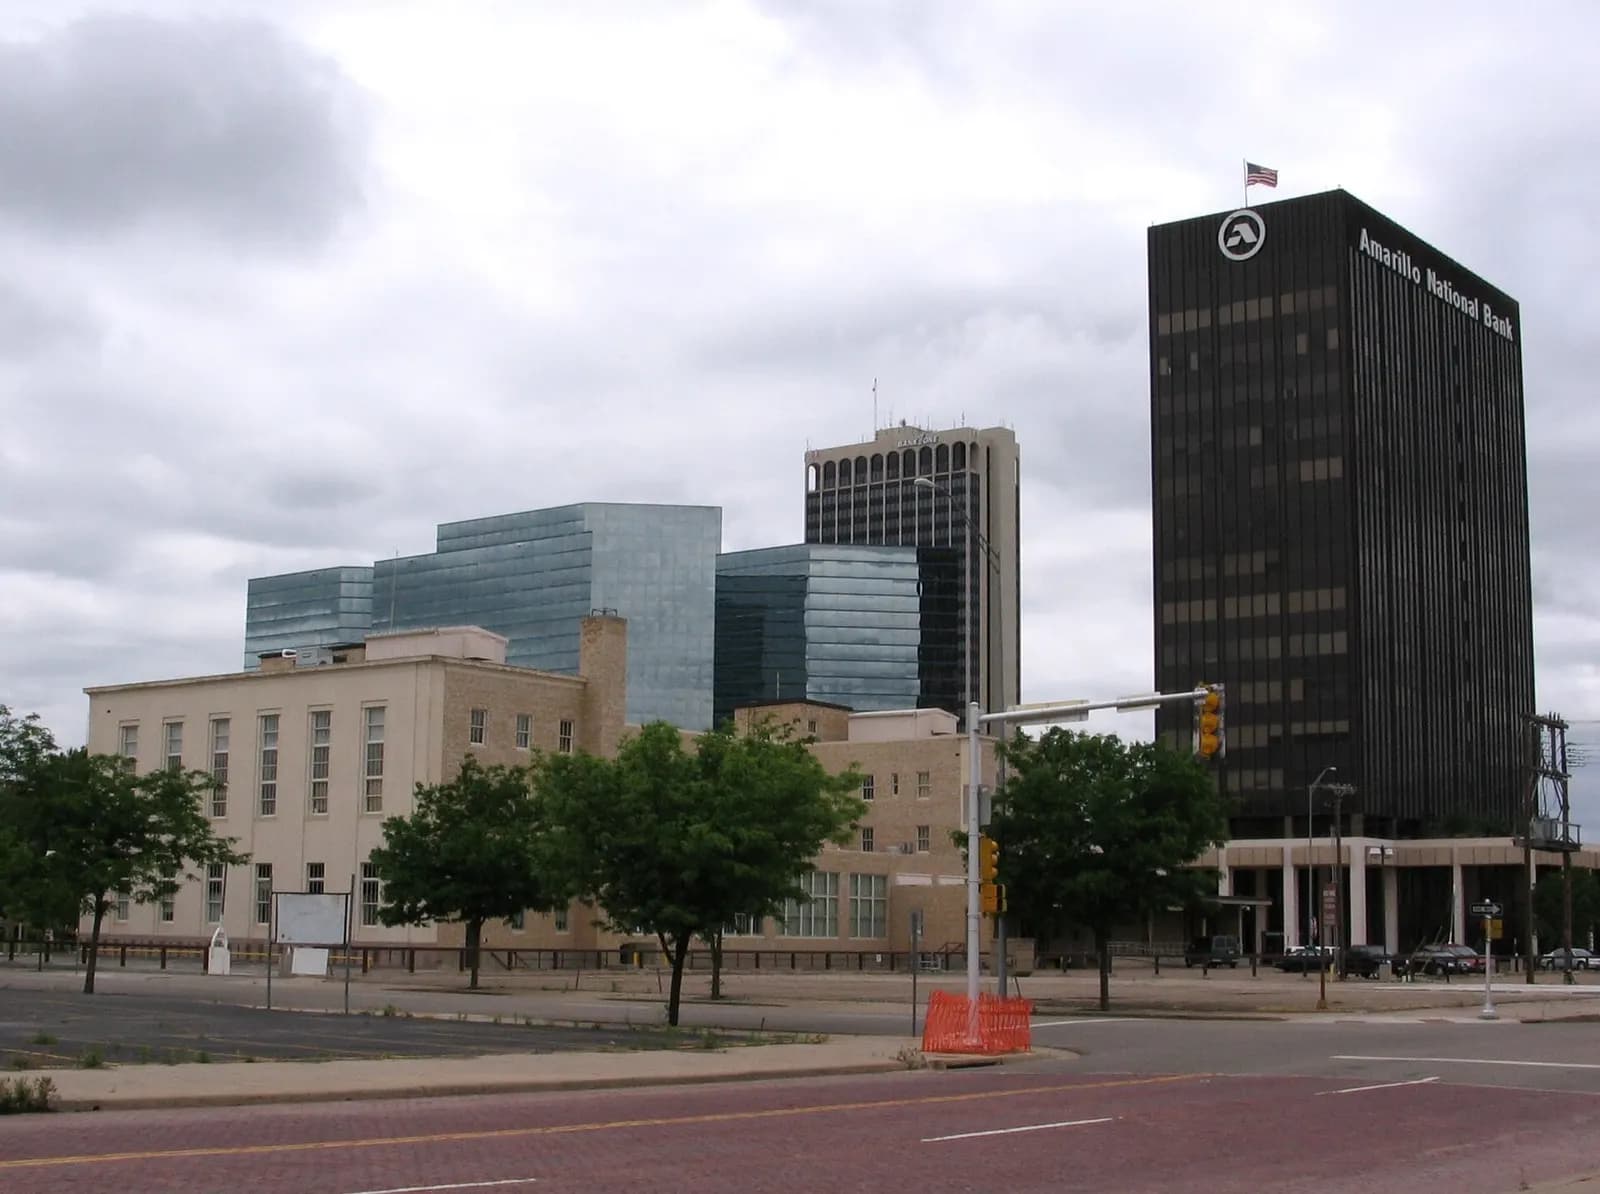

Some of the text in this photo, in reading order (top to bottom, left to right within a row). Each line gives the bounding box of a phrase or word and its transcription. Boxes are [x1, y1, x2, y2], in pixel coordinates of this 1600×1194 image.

[1359, 227, 1514, 342] Amarillo National Bank
